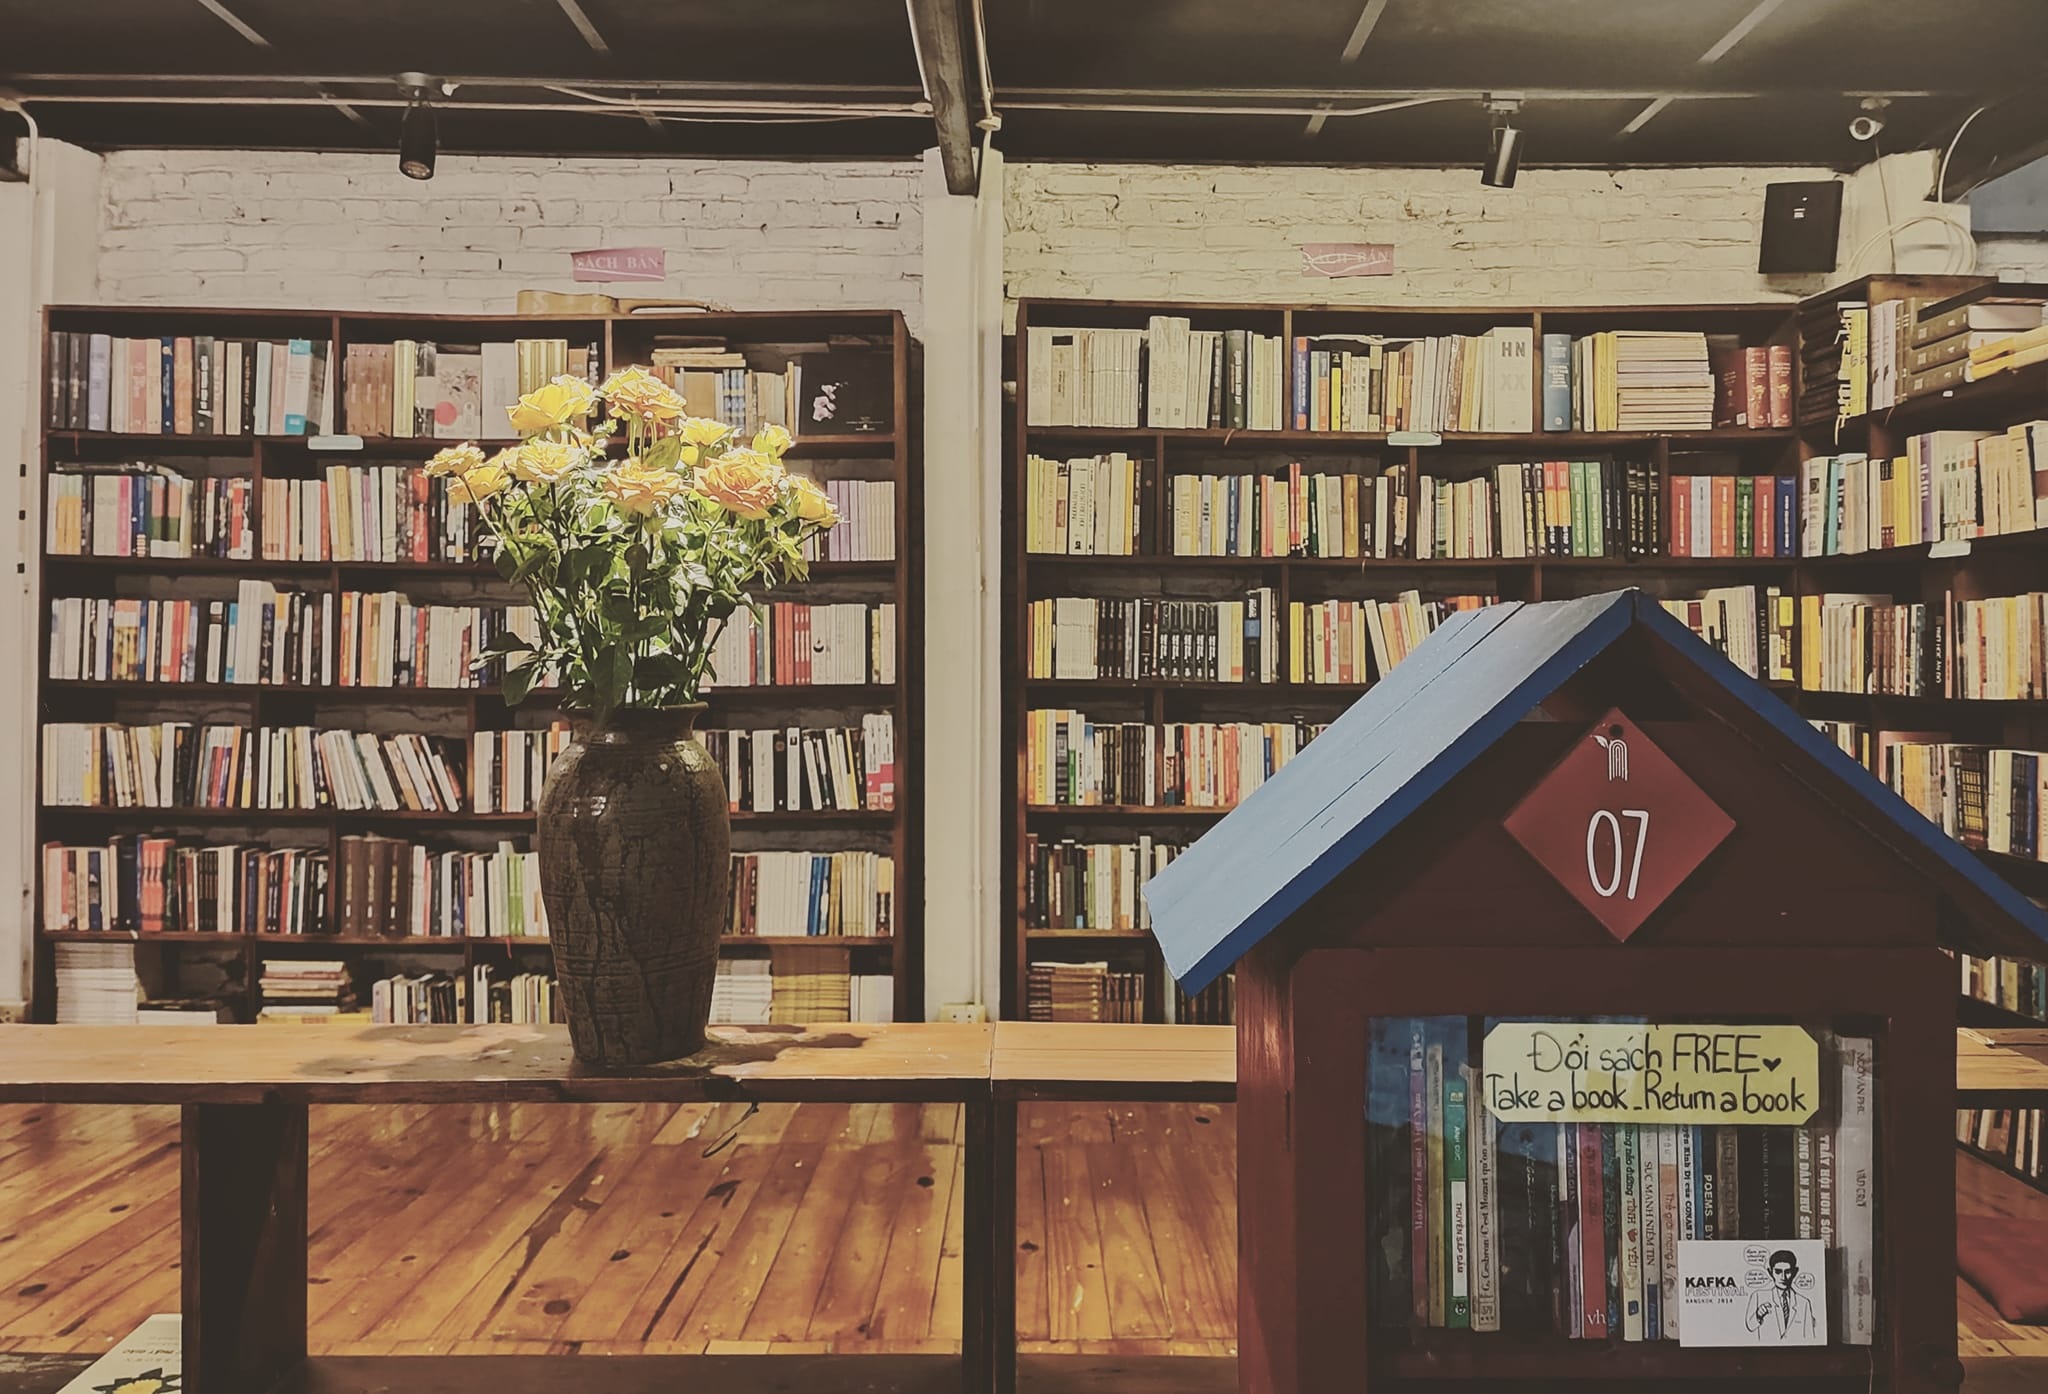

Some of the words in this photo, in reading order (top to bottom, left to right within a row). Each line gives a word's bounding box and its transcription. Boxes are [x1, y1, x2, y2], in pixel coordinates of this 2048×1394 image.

[1586, 809, 1650, 900] 07
[1526, 1031, 1589, 1073] Đổi
[1599, 1032, 1663, 1073] sách
[1672, 1033, 1762, 1074] FREE
[1485, 1072, 1541, 1111] Take
[1548, 1089, 1566, 1112] a
[1571, 1071, 1629, 1113] book
[1644, 1069, 1716, 1112] Return
[1720, 1092, 1738, 1113] a
[1742, 1074, 1807, 1114] book
[1480, 1178, 1489, 1210] Mozart
[1704, 1174, 1713, 1217] POEMS
[1820, 1192, 1831, 1215] NON
[1685, 1200, 1693, 1231] CONAN
[1705, 1224, 1713, 1240] BY
[1684, 1286, 1749, 1297] FESTIVAL
[1685, 1277, 1737, 1288] KAFKA
